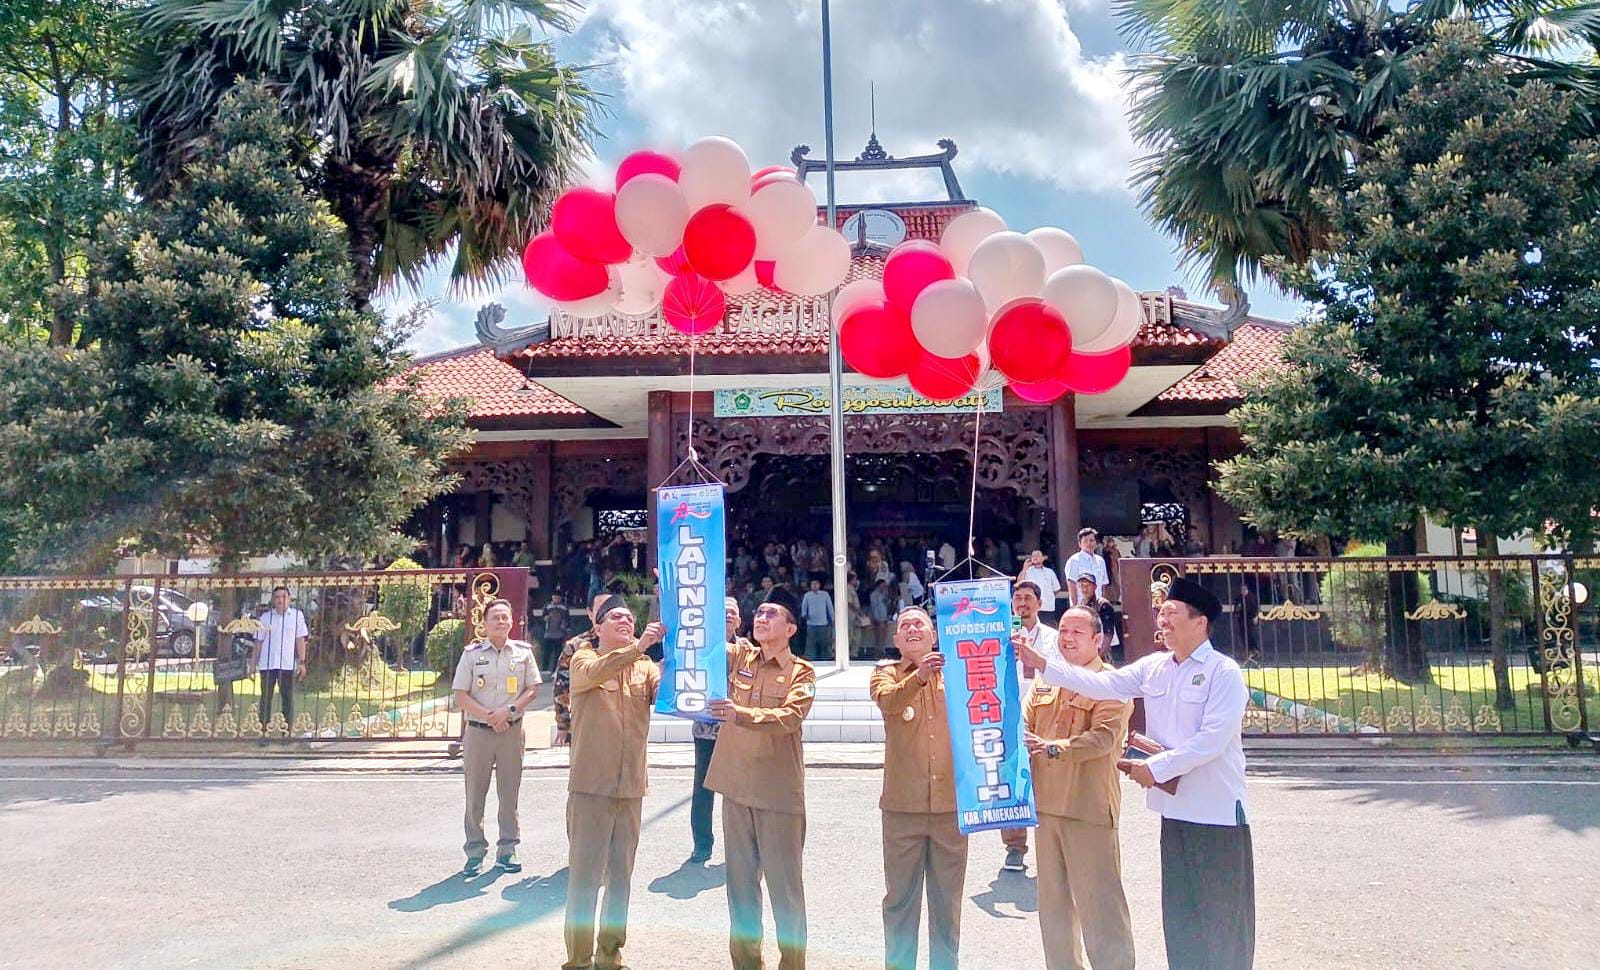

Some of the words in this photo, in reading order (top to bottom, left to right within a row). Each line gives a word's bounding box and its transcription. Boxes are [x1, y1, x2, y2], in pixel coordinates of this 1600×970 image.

[550, 304, 720, 338] MANDH
[736, 299, 831, 334] AGHUN
[675, 525, 707, 712] LAUNCHING
[956, 638, 1002, 725] MERAH
[971, 727, 1011, 803] PUTIH
[963, 810, 982, 826] KAB.
[983, 805, 1031, 823] PAMEKASAN
